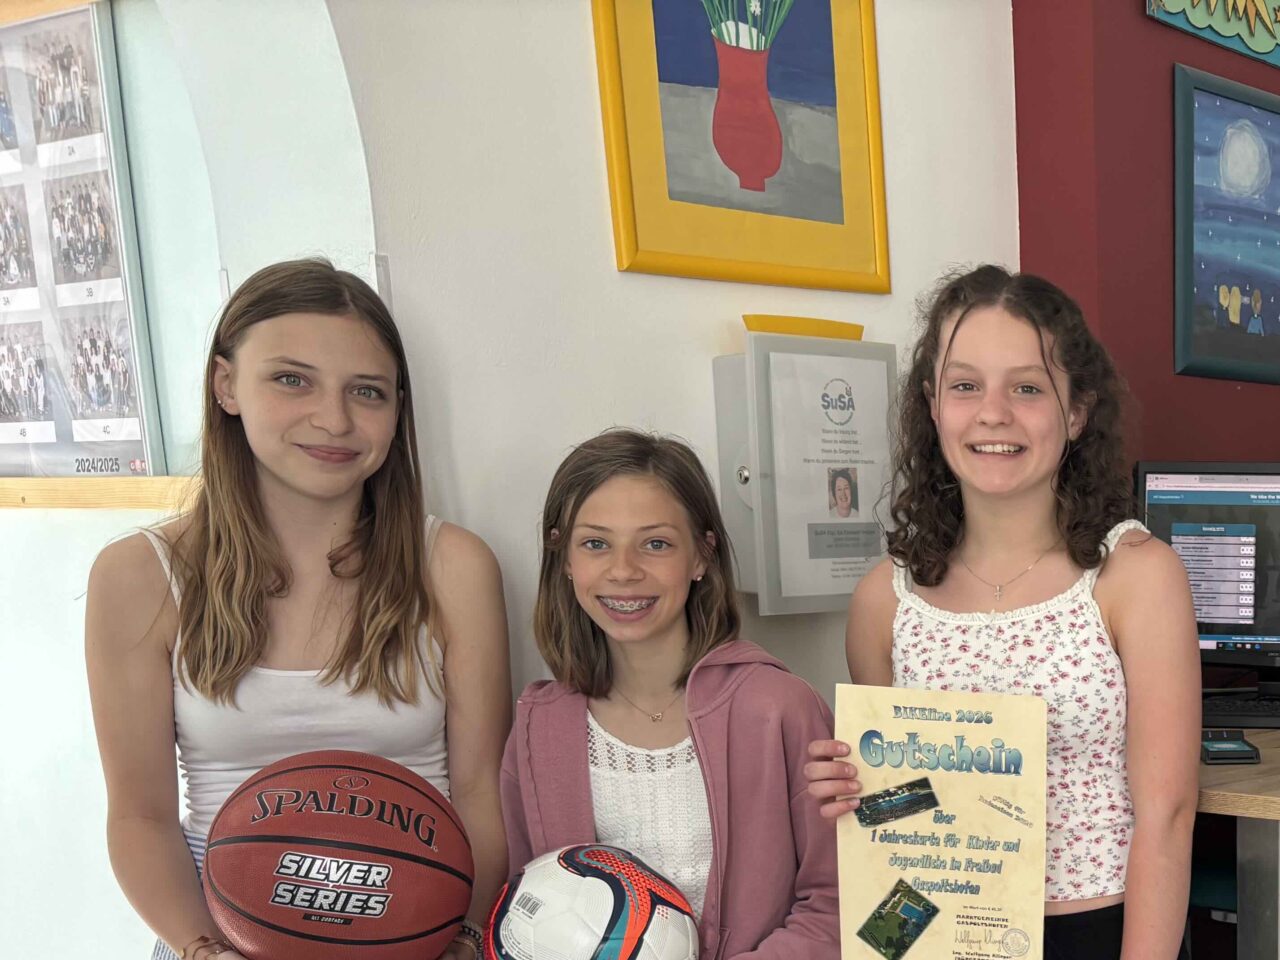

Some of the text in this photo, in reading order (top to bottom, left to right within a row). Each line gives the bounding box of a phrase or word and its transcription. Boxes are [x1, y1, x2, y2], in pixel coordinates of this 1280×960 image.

[821, 392, 856, 411] SuSA
[75, 457, 120, 472] 2024/2025
[955, 709, 994, 725] 2026
[859, 729, 1024, 777] Gutschein
[250, 788, 437, 850] SPALDING
[933, 809, 957, 825] über
[870, 829, 1022, 853] 1 Jahreskarte für Kinder und
[276, 853, 390, 889] SILVER
[888, 852, 947, 871] Jugendliche
[963, 857, 1004, 875] Freibad
[271, 882, 389, 917] SERIES
[956, 914, 1009, 923] MARKTGEMEINDE
[956, 920, 1009, 929] GASPOLTSHOFEN
[965, 951, 991, 959] Wolfgang
